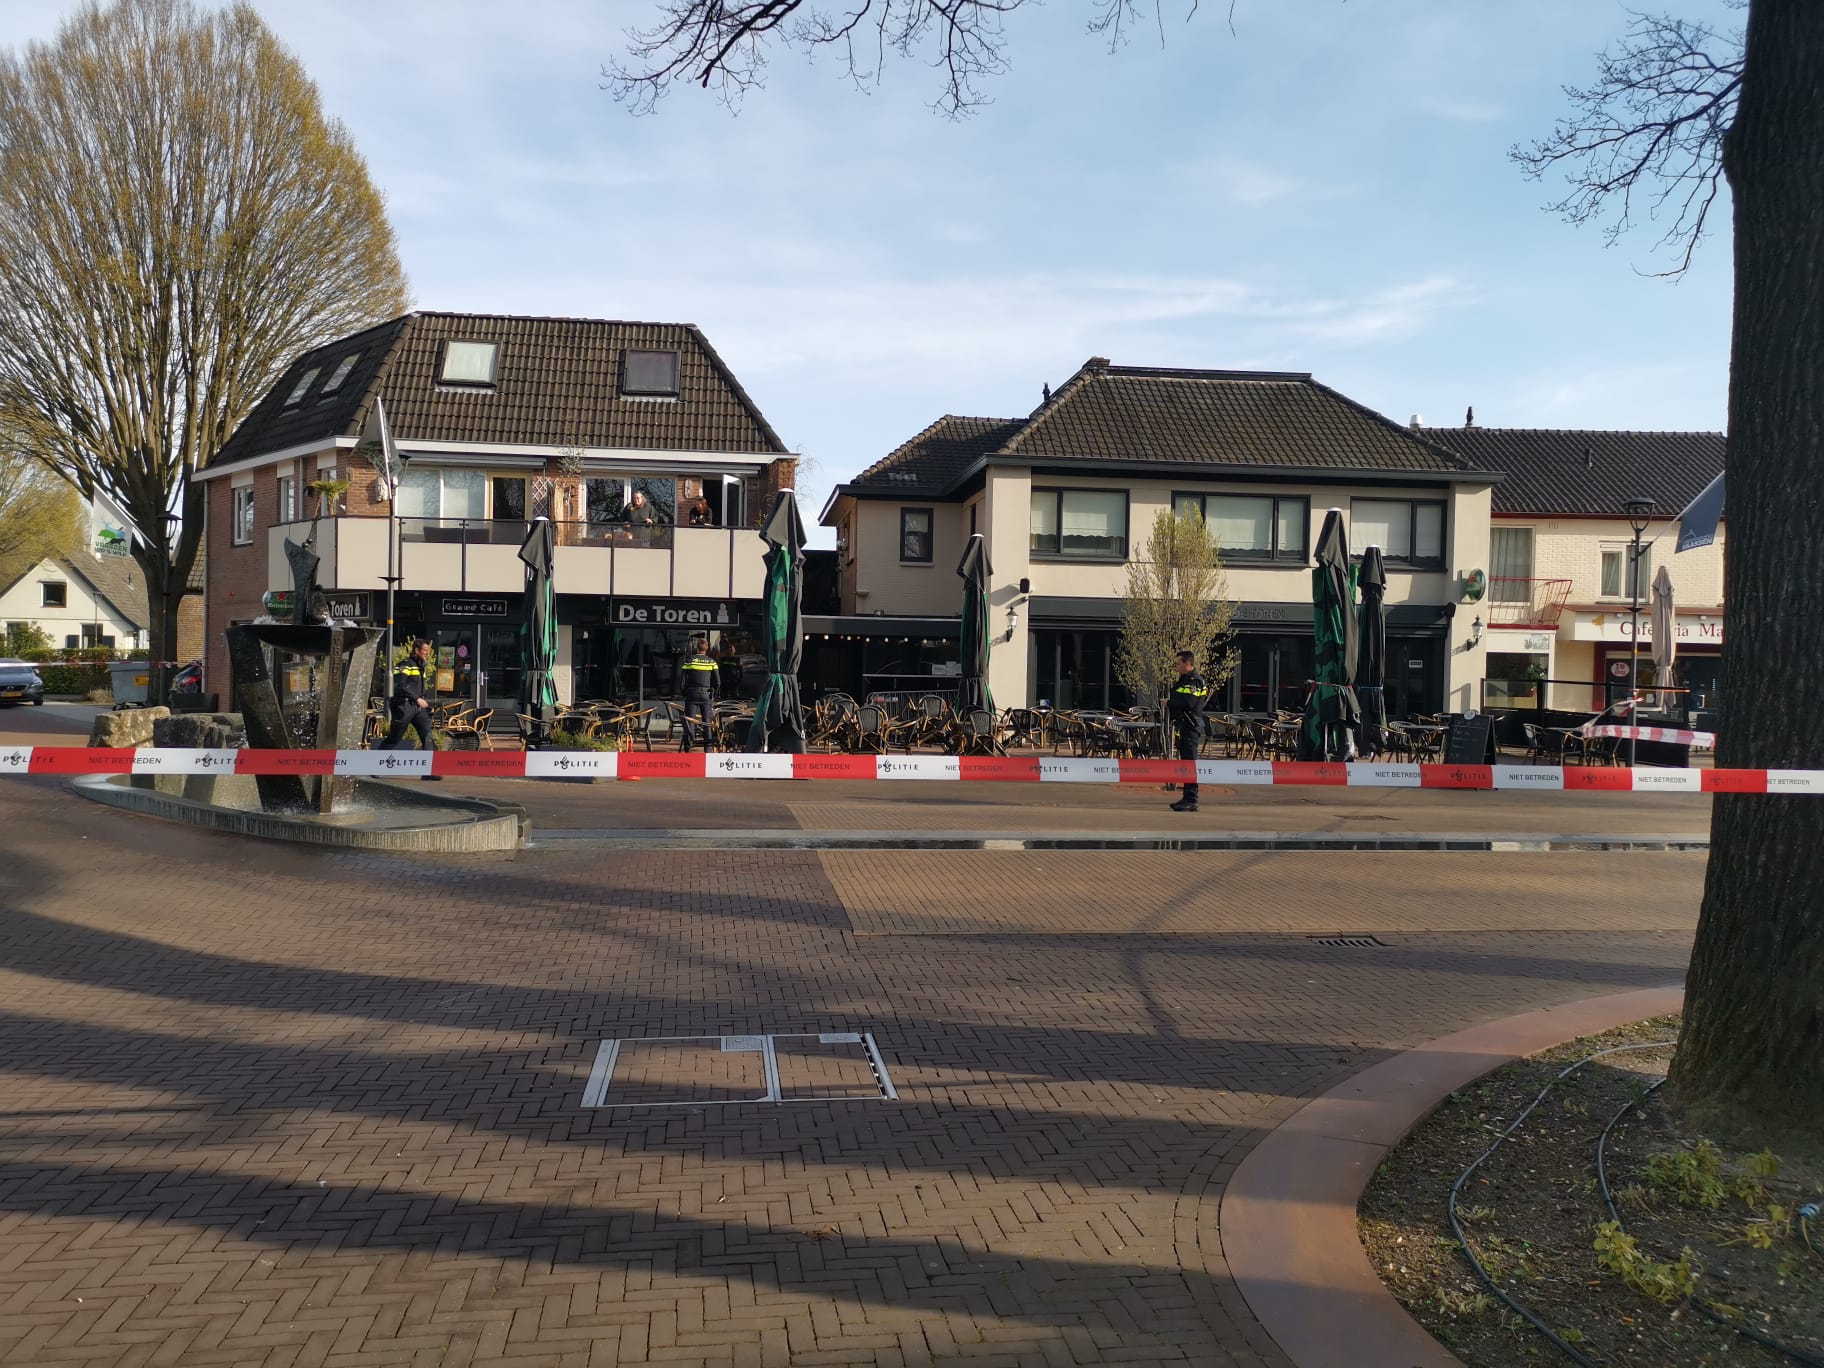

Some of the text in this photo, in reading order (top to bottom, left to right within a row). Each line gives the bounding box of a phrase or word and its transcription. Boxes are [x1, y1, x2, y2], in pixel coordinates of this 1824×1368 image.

[330, 601, 354, 617] Toren
[619, 604, 712, 623] De Toren
[1620, 621, 1689, 637] Cfeia
[89, 757, 161, 765] NIET BETREDEN
[195, 752, 246, 767] POLITIE
[277, 758, 347, 766] NIET BETREDEN
[379, 753, 428, 769] POLITIE
[554, 754, 599, 769] POLITIE
[719, 756, 763, 771] POLITIE
[877, 758, 919, 773] POLITIE
[790, 762, 807, 770] NIET
[945, 764, 1003, 772] NIET BETREDEN
[1028, 762, 1069, 774] POLITIE
[1237, 768, 1253, 776] NIET
[1391, 771, 1427, 779] BETREDEN
[1653, 776, 1687, 784] BETREDEN
[1778, 778, 1810, 786] BETREDEN
